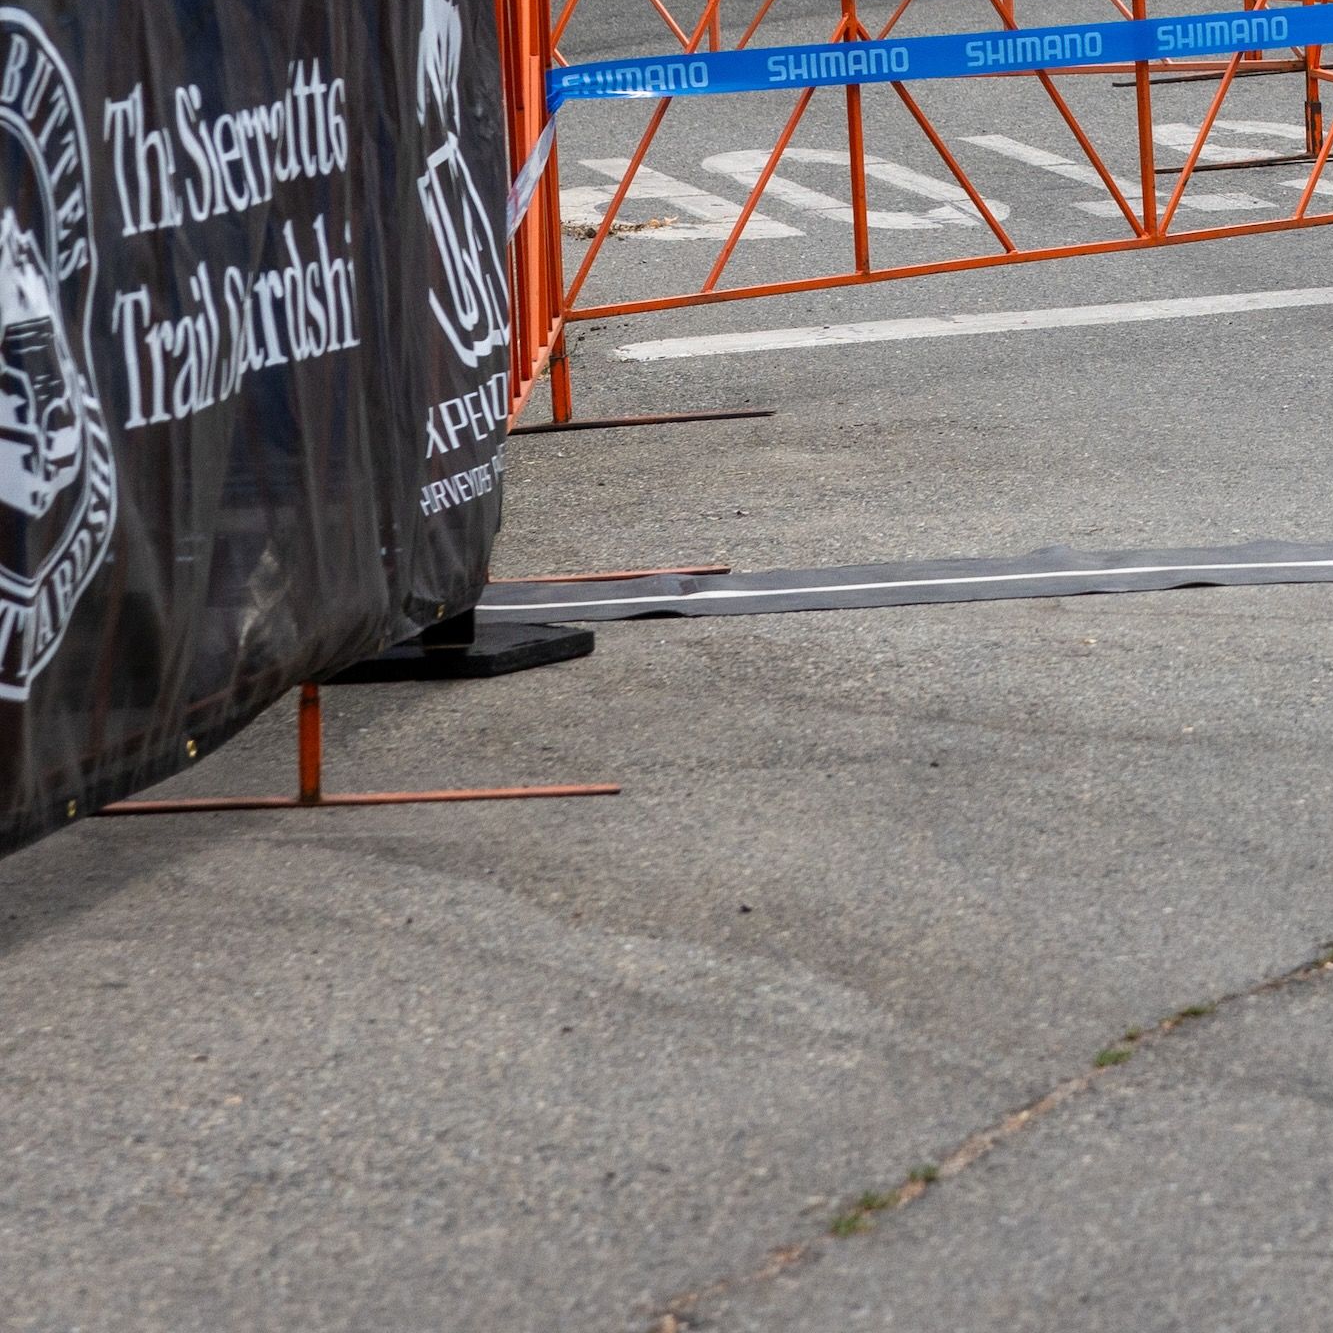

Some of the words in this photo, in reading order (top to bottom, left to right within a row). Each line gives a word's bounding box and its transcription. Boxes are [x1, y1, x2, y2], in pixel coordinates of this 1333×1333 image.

[561, 61, 709, 95] SHIMANO
[768, 46, 910, 83] SHIMANO
[965, 31, 1102, 67] SHIMANO
[1156, 15, 1288, 52] SHIMANO
[112, 260, 220, 430] Trail
